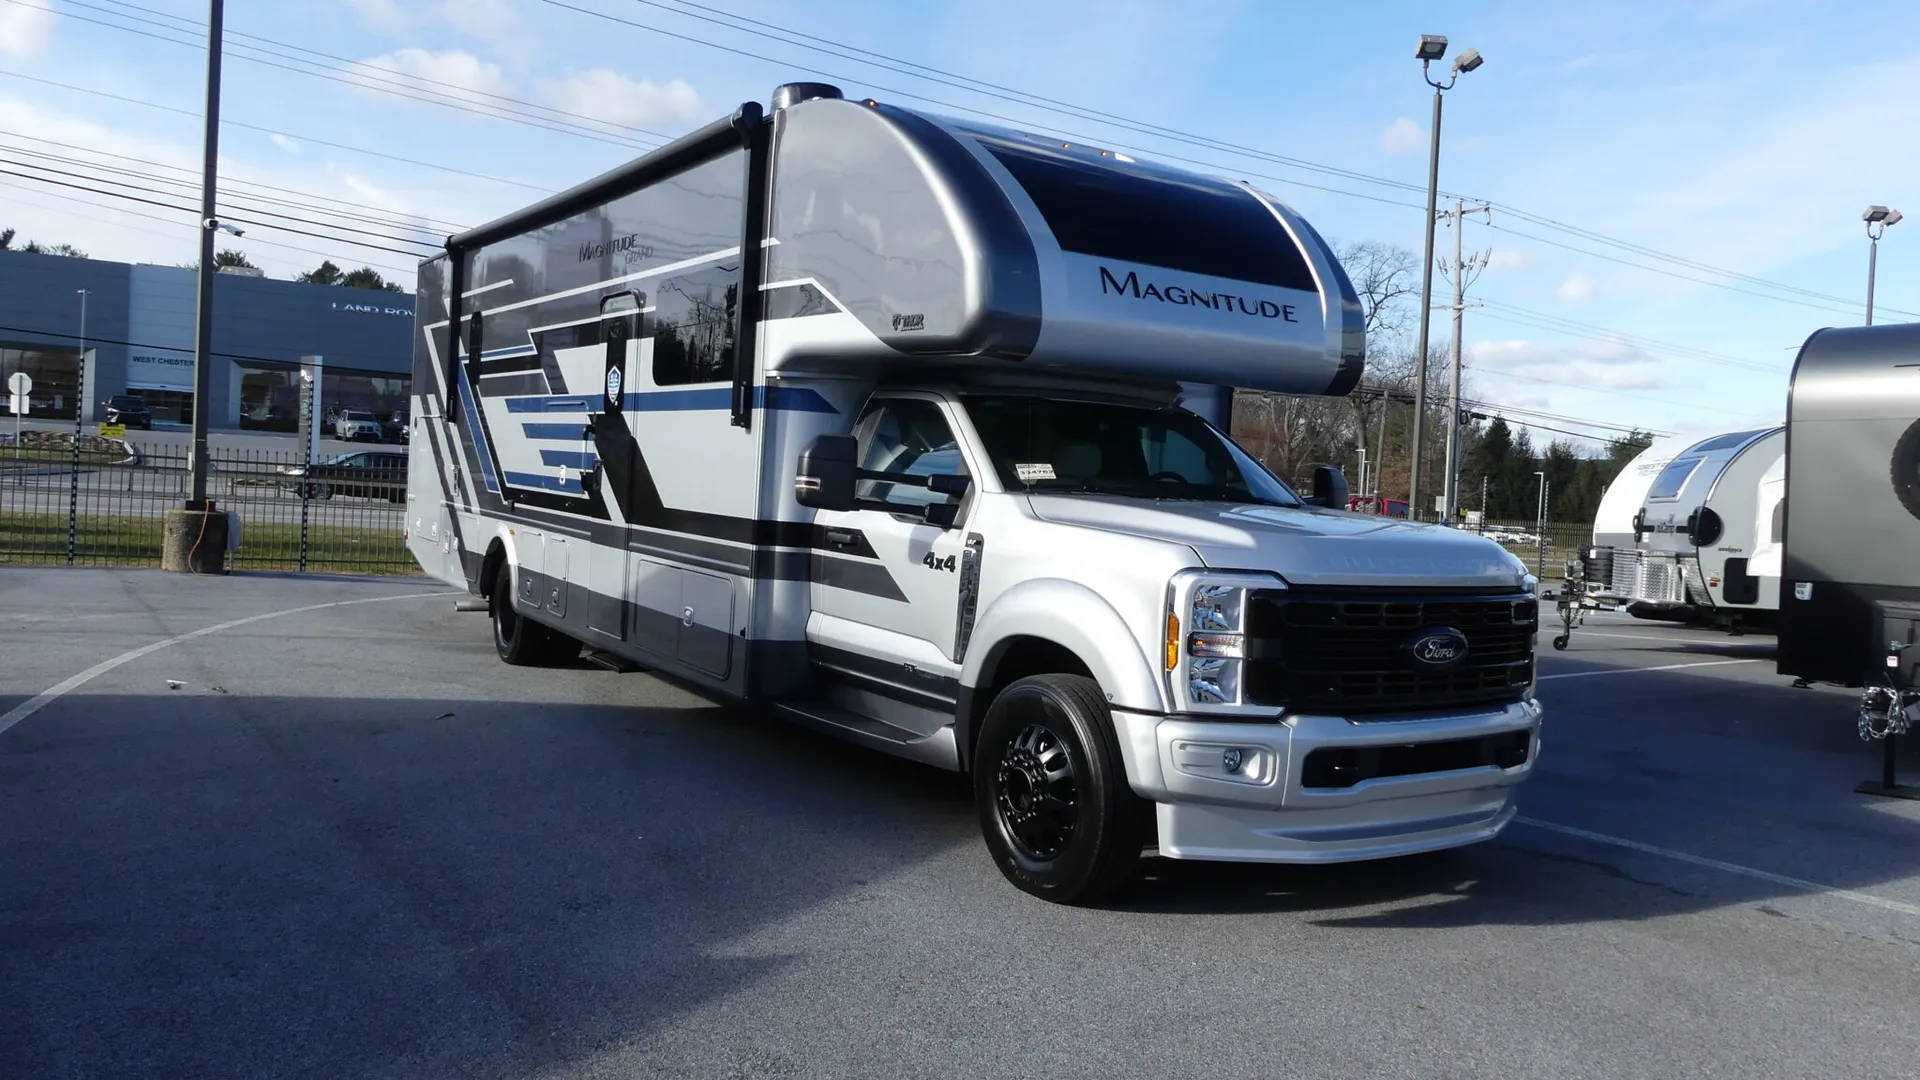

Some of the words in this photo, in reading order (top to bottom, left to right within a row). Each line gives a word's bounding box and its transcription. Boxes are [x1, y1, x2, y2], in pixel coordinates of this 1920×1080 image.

[625, 246, 654, 264] GRAND
[332, 302, 380, 313] LAND
[901, 314, 925, 328] THOR
[158, 358, 195, 367] CHESTER
[923, 551, 956, 573] 4x4
[1424, 639, 1456, 659] Ford
